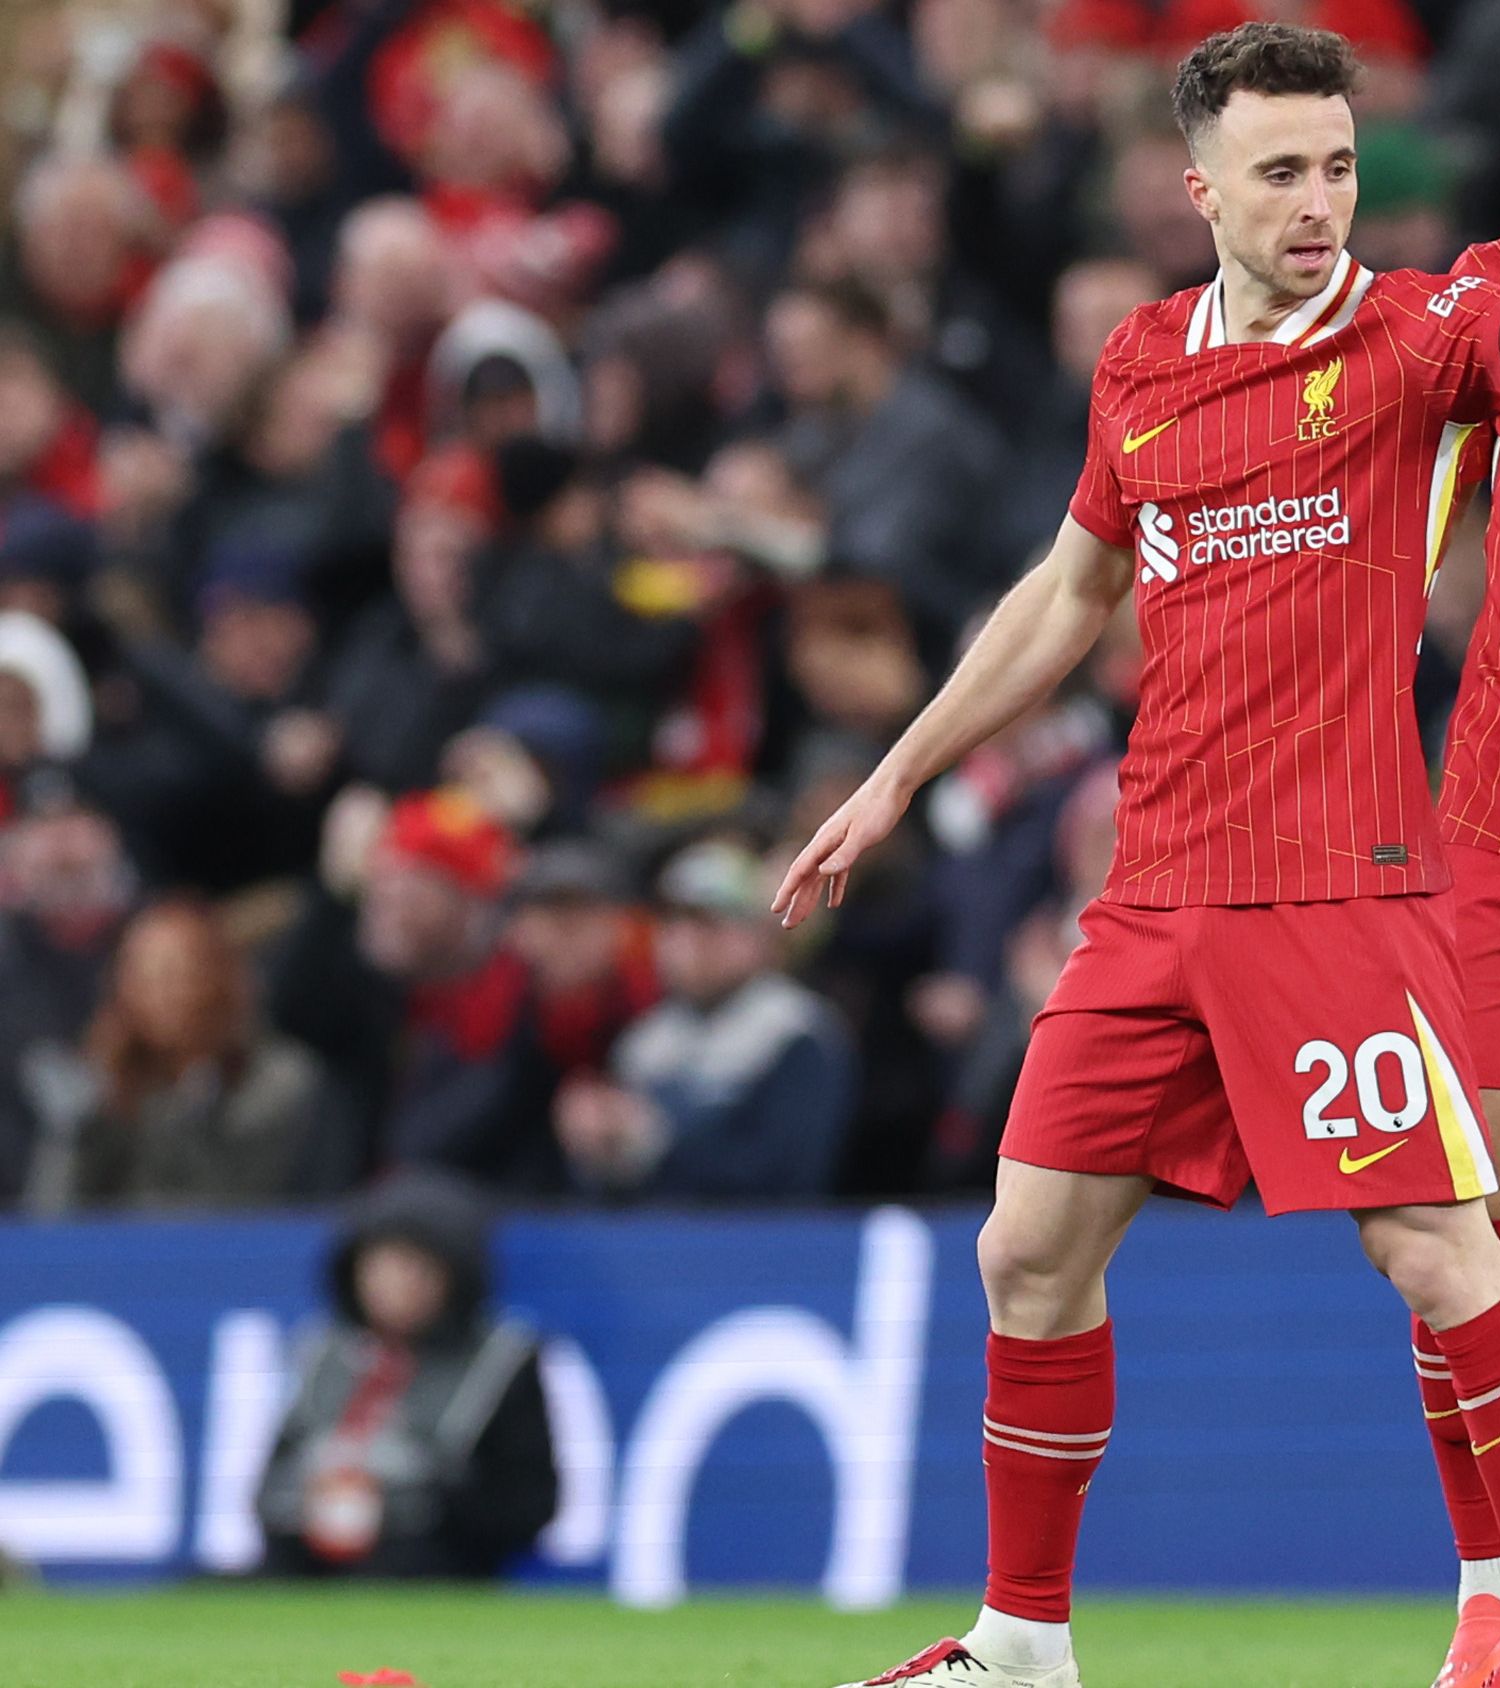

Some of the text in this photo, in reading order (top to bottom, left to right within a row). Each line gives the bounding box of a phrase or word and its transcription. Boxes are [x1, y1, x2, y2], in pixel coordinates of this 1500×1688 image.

[1188, 487, 1340, 536] standard
[1191, 515, 1350, 565] chartered
[1294, 1031, 1428, 1140] 20
